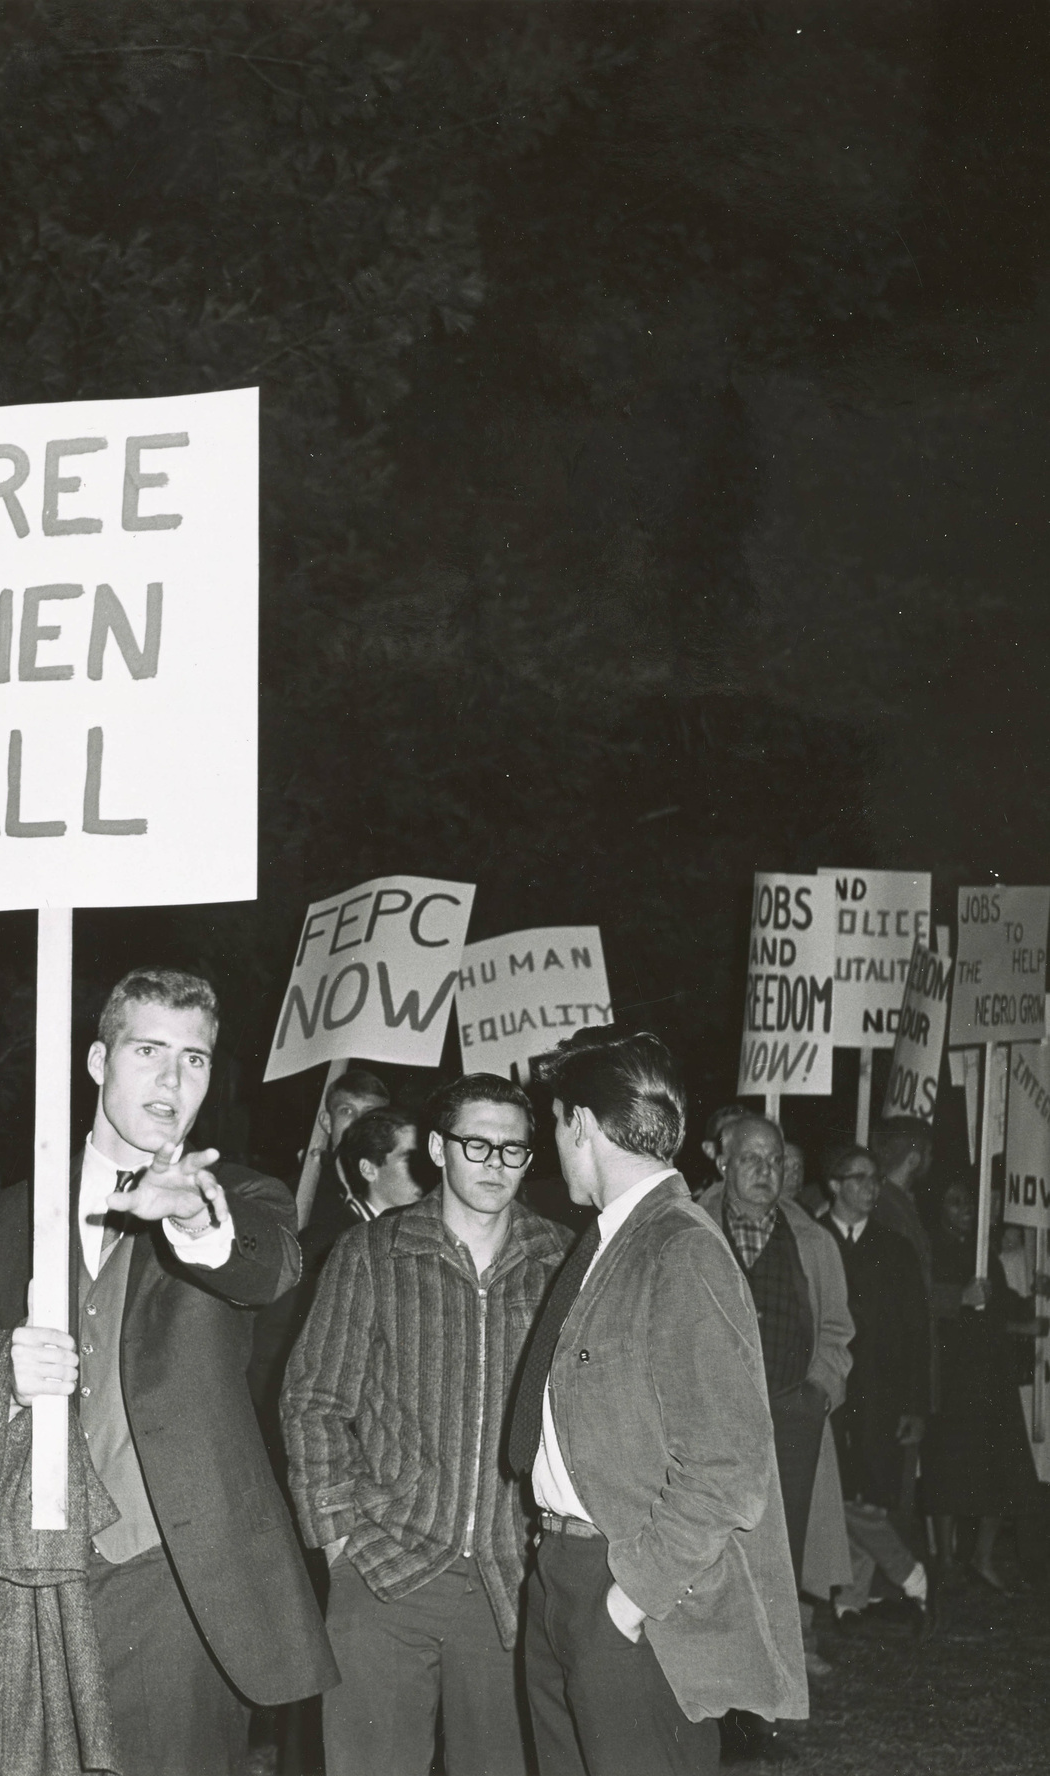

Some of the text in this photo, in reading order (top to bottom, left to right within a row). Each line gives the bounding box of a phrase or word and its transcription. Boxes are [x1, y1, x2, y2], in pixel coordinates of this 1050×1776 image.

[836, 878, 867, 901] ND
[838, 908, 929, 938] OLICE
[960, 893, 1001, 924] JOBS
[296, 889, 462, 966] FEPC
[1004, 921, 1024, 943] TO
[459, 947, 592, 991] HUMAN
[958, 960, 982, 984] THE
[1012, 948, 1045, 974] HELP
[276, 961, 458, 1049] NOW
[974, 993, 1017, 1027] NEGRO
[462, 1004, 611, 1048] EQUALITY
[862, 1008, 901, 1034] NO
[1013, 1053, 1050, 1126] INTEG
